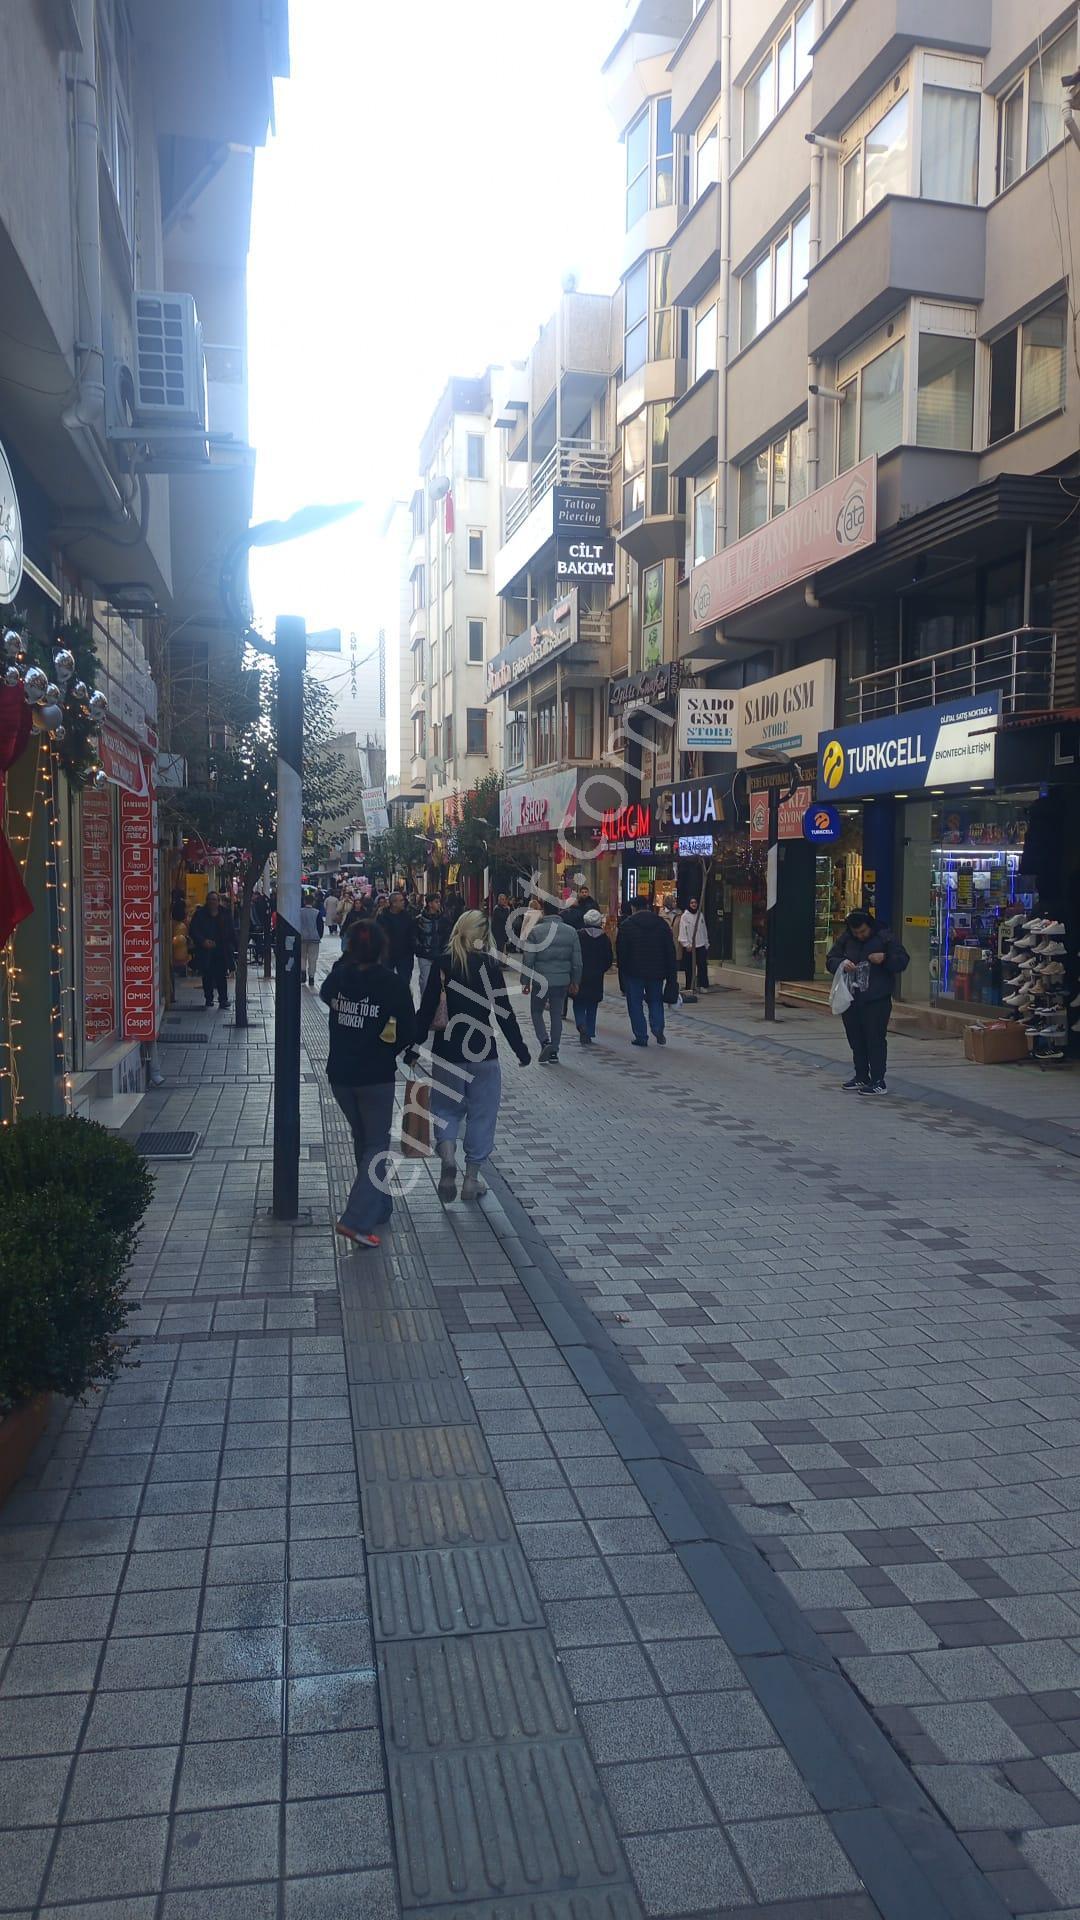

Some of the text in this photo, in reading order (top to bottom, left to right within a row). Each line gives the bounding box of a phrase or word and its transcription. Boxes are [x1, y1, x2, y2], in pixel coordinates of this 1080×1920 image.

[564, 499, 596, 510] Tattoo
[559, 511, 600, 524] Piercing
[569, 542, 604, 558] CİLT
[557, 561, 614, 576] BAKIMI
[687, 698, 734, 711] SADO
[744, 680, 815, 725] SADO GSM
[690, 713, 728, 725] GSM
[687, 727, 733, 737] STORE
[761, 720, 789, 739] STORE
[847, 734, 927, 774] TURKCELL
[967, 741, 991, 755] İLETİŞİM
[672, 787, 717, 825] LUJA
[125, 884, 148, 892] realme
[125, 910, 150, 919] vivo
[339, 1000, 360, 1014] MADE
[360, 1003, 369, 1016] TO
[369, 1005, 380, 1018] BE
[127, 1018, 151, 1030] Casper
[338, 1012, 364, 1029] BROKEN
